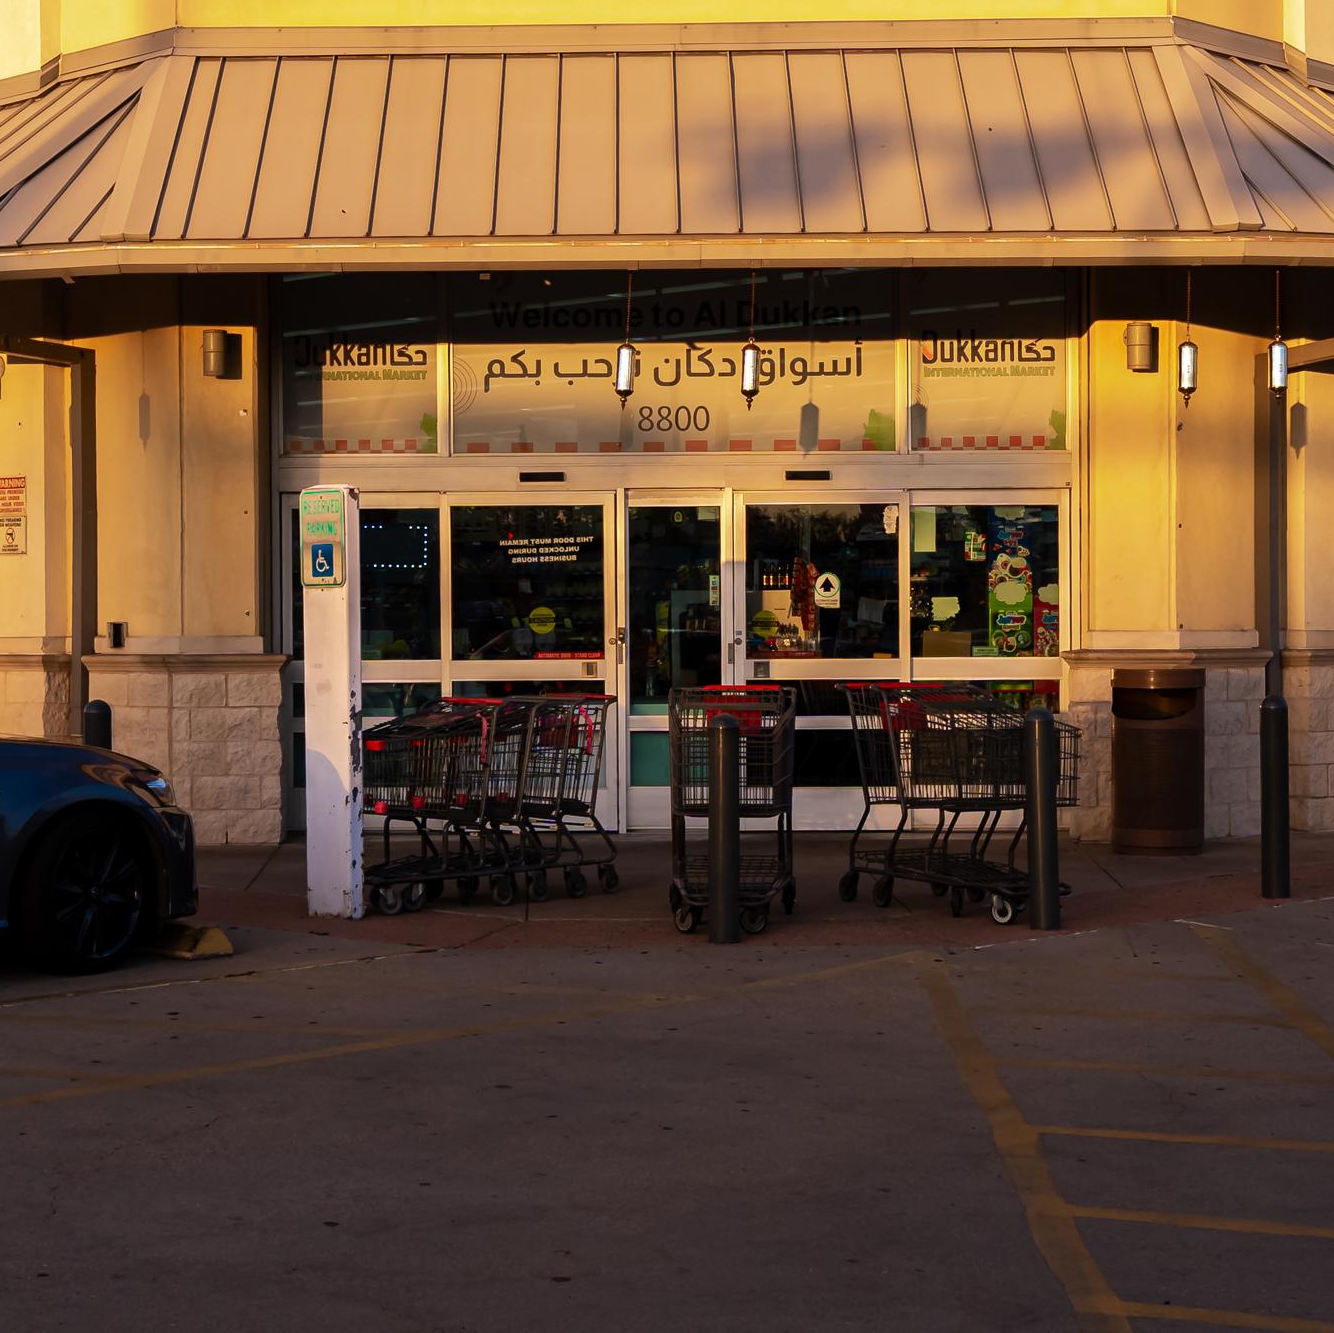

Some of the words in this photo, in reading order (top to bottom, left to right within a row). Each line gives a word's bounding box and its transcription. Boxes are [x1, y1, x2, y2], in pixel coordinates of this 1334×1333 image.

[490, 301, 643, 329] Welcome
[651, 304, 685, 328] to
[694, 299, 725, 328] Al
[737, 299, 861, 328] Dukkan
[382, 368, 427, 381] MARKET
[483, 349, 542, 393] بكم
[653, 348, 736, 387] دكان
[923, 365, 1009, 378] INTERNATIONAL
[1010, 365, 1055, 377] MARKET
[637, 405, 710, 432] 8800
